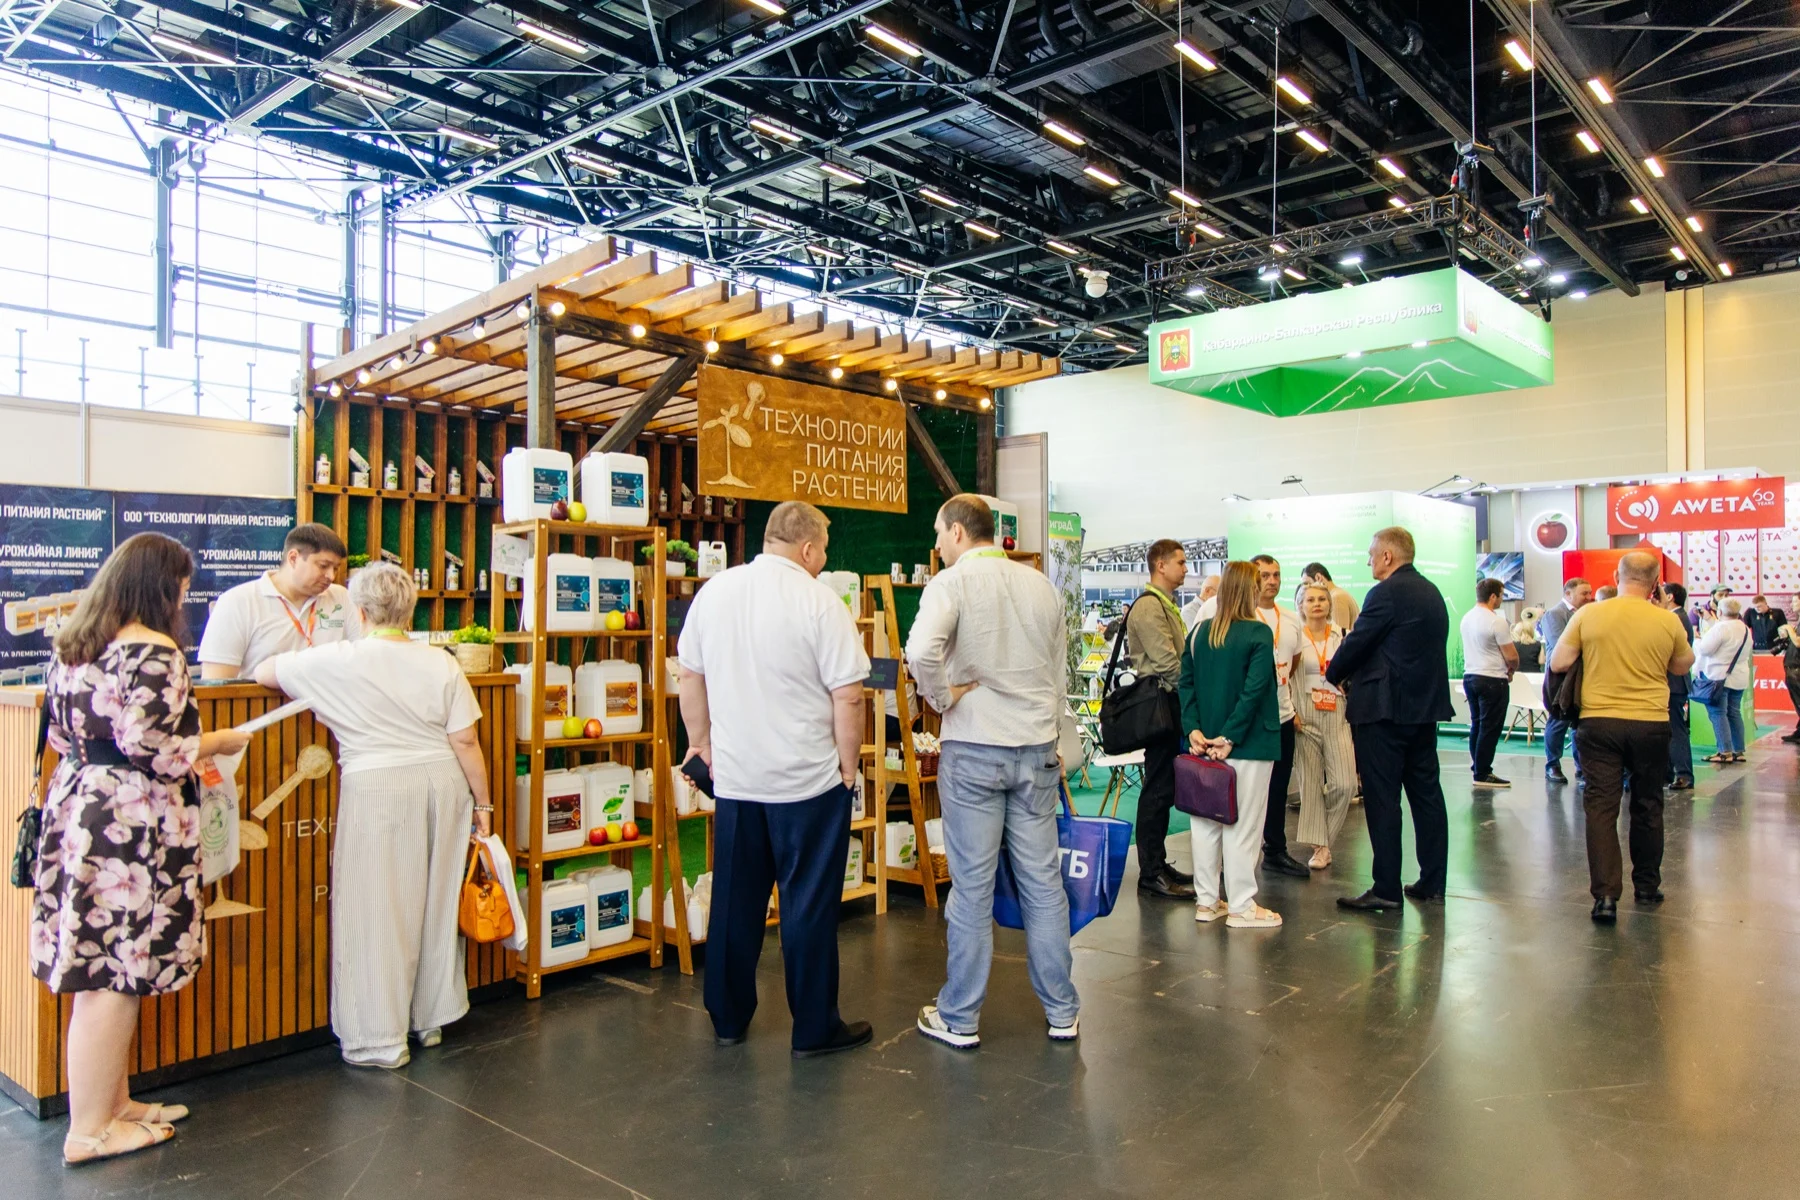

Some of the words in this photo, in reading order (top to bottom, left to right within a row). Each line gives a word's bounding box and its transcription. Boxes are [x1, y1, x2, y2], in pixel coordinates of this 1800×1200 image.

[1203, 318, 1352, 352] Кабардино-Балкарская
[1356, 302, 1443, 328] Республика
[759, 406, 904, 451] ТЕХНОЛОГИИ
[806, 443, 904, 478] ПИТАНИЯ
[792, 469, 905, 504] РАСТЕНИЙ
[1671, 496, 1757, 515] AWETA
[1752, 488, 1775, 502] 60
[3, 504, 51, 519] ПИТАНИЯ
[123, 511, 142, 523] ООО
[208, 513, 247, 526] ПИТАНИЯ
